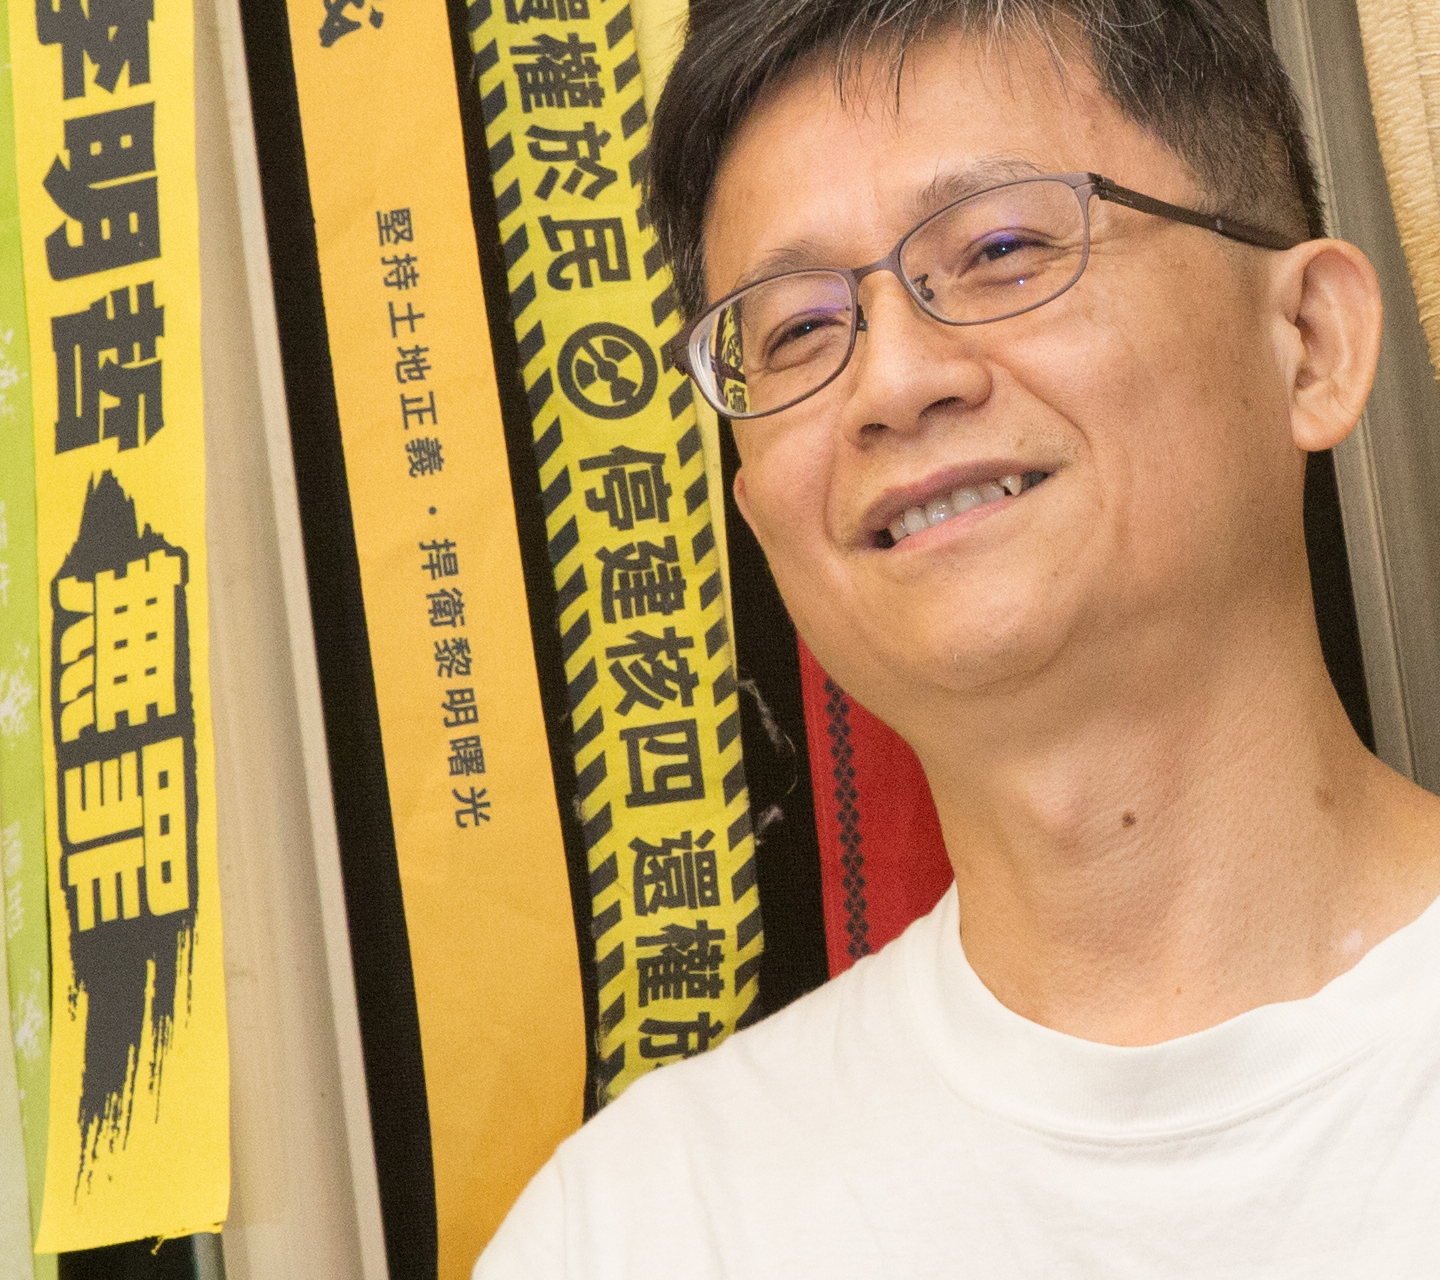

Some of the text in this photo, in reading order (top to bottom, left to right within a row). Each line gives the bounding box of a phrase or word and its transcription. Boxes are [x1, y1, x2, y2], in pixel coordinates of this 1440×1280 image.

[49, 550, 191, 932] 無罪
[578, 443, 707, 811] 停建核四
